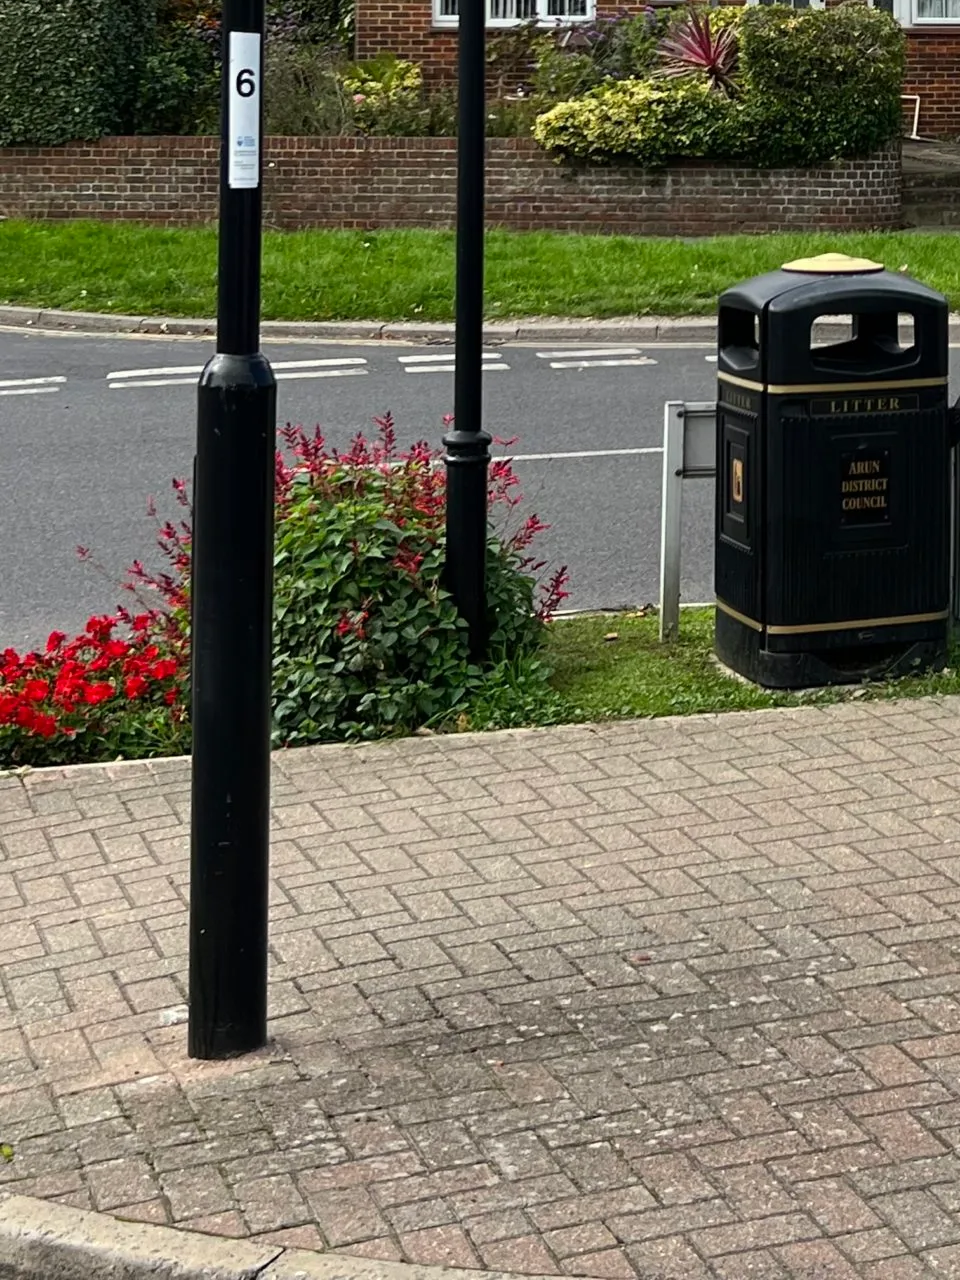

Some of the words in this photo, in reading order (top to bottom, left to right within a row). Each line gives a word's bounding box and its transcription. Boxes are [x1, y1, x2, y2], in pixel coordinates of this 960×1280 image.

[236, 68, 256, 98] 6
[725, 391, 751, 410] LITTER
[830, 398, 900, 414] LITTER
[848, 460, 880, 475] ARUN
[841, 478, 889, 493] DISTRICT
[841, 495, 888, 510] COUNCIL
